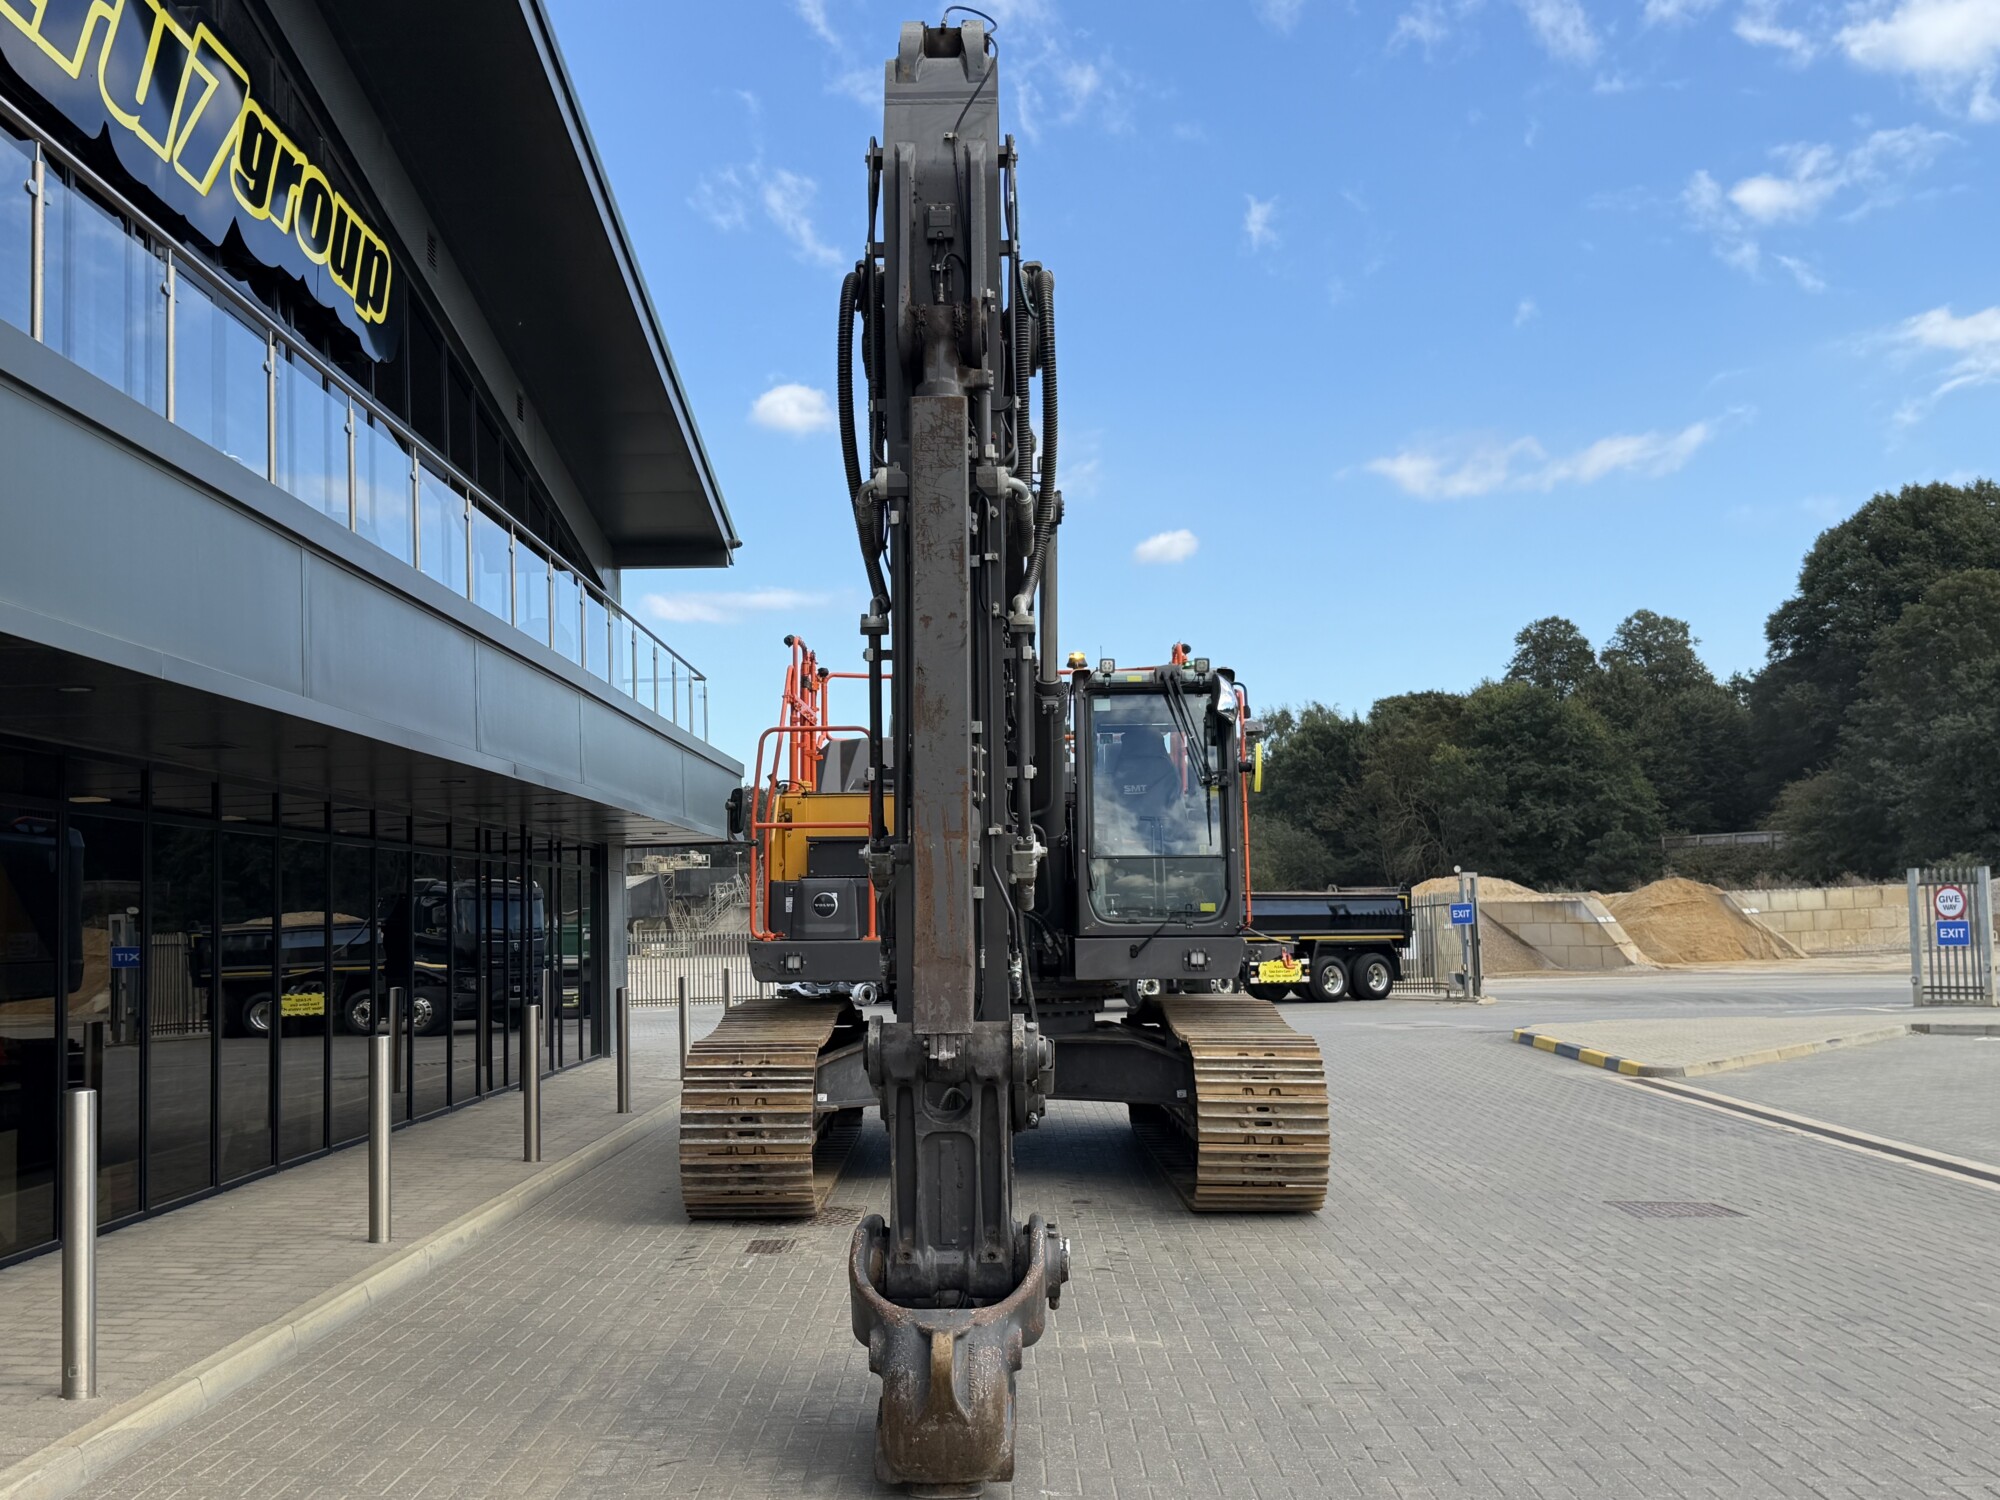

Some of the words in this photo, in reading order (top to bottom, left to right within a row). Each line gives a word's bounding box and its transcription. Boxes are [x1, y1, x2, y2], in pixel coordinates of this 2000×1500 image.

[230, 97, 392, 324] group
[1123, 784, 1147, 792] SMT
[1938, 895, 1960, 903] GIVE
[1452, 909, 1471, 918] EXIT
[1940, 928, 1965, 938] EXIT
